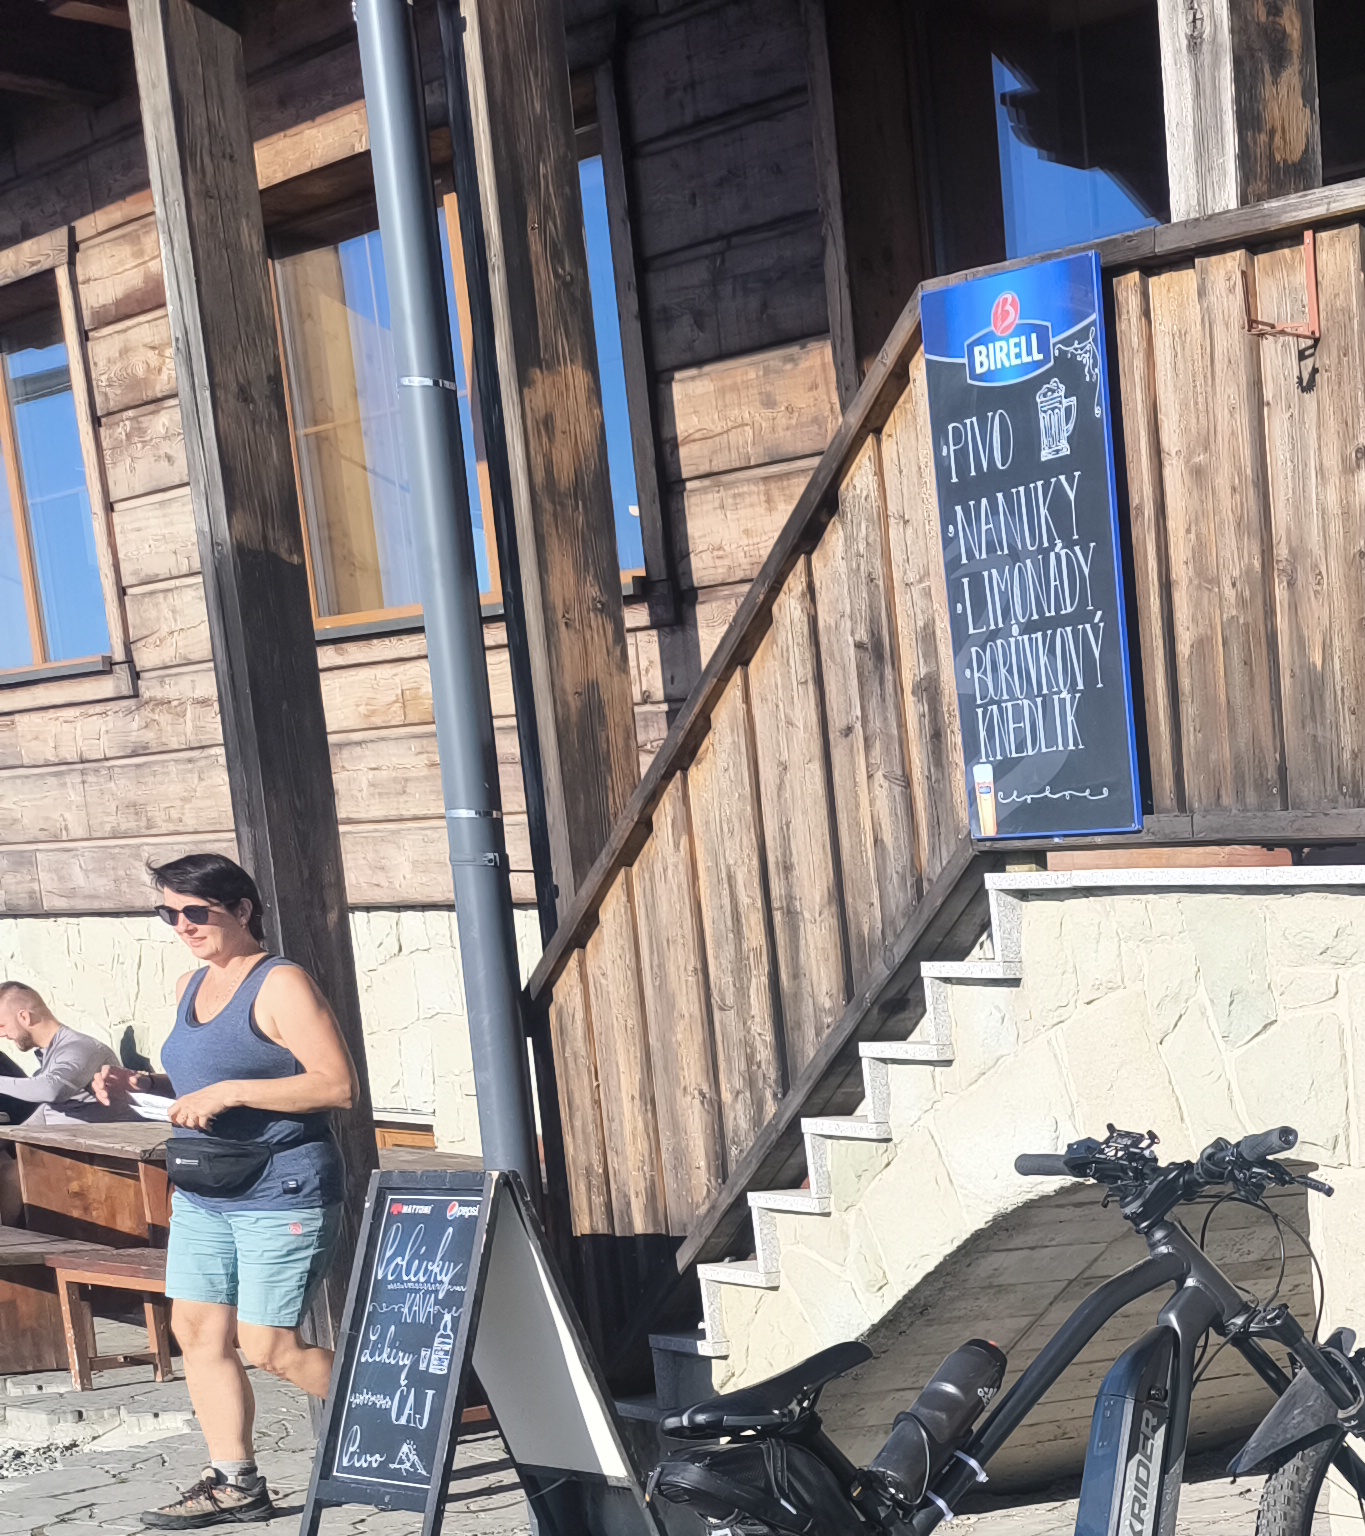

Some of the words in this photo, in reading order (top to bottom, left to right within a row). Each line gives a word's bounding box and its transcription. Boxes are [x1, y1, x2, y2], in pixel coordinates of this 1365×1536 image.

[971, 332, 1045, 375] BIRELL
[946, 409, 1014, 482] PIVO
[954, 471, 1082, 564] NANUKY
[961, 542, 1096, 635] LIMONÁDY
[377, 1222, 464, 1299] Polévky
[401, 1288, 435, 1325] KÁVA
[391, 1379, 435, 1430] ČAJ
